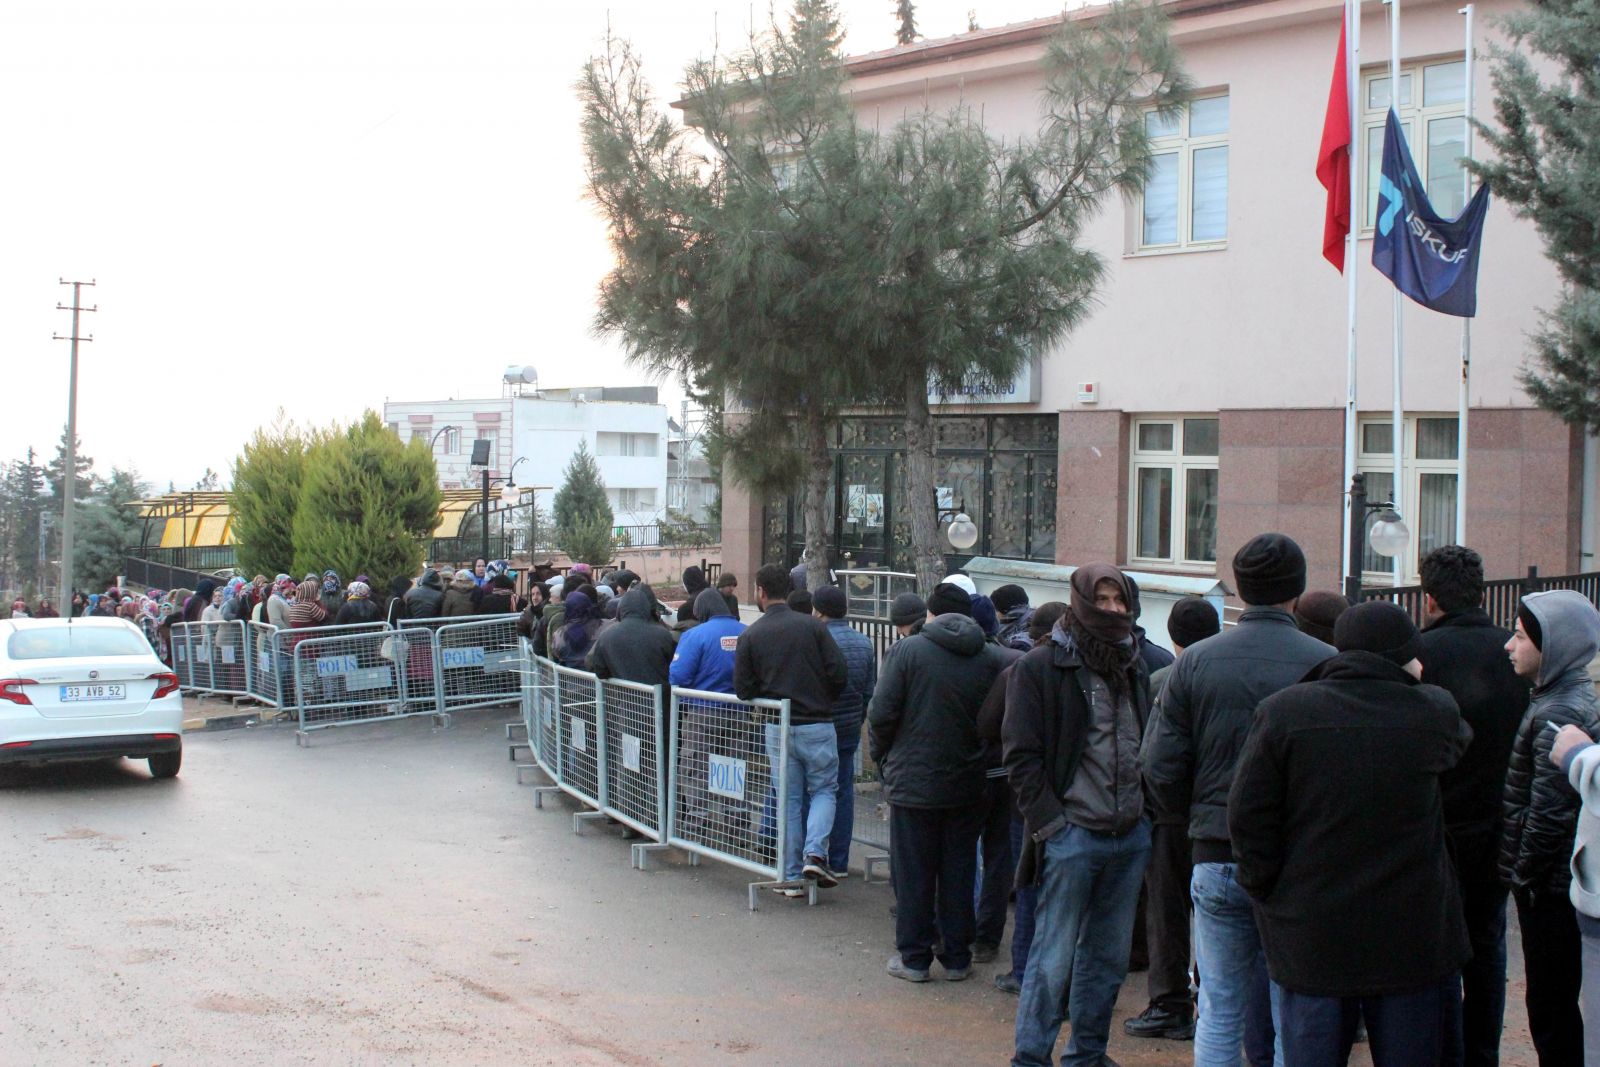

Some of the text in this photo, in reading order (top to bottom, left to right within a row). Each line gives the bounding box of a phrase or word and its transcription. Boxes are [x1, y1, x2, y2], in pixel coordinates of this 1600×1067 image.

[68, 685, 121, 698] 33 AVB 52
[710, 759, 744, 794] POLİS
